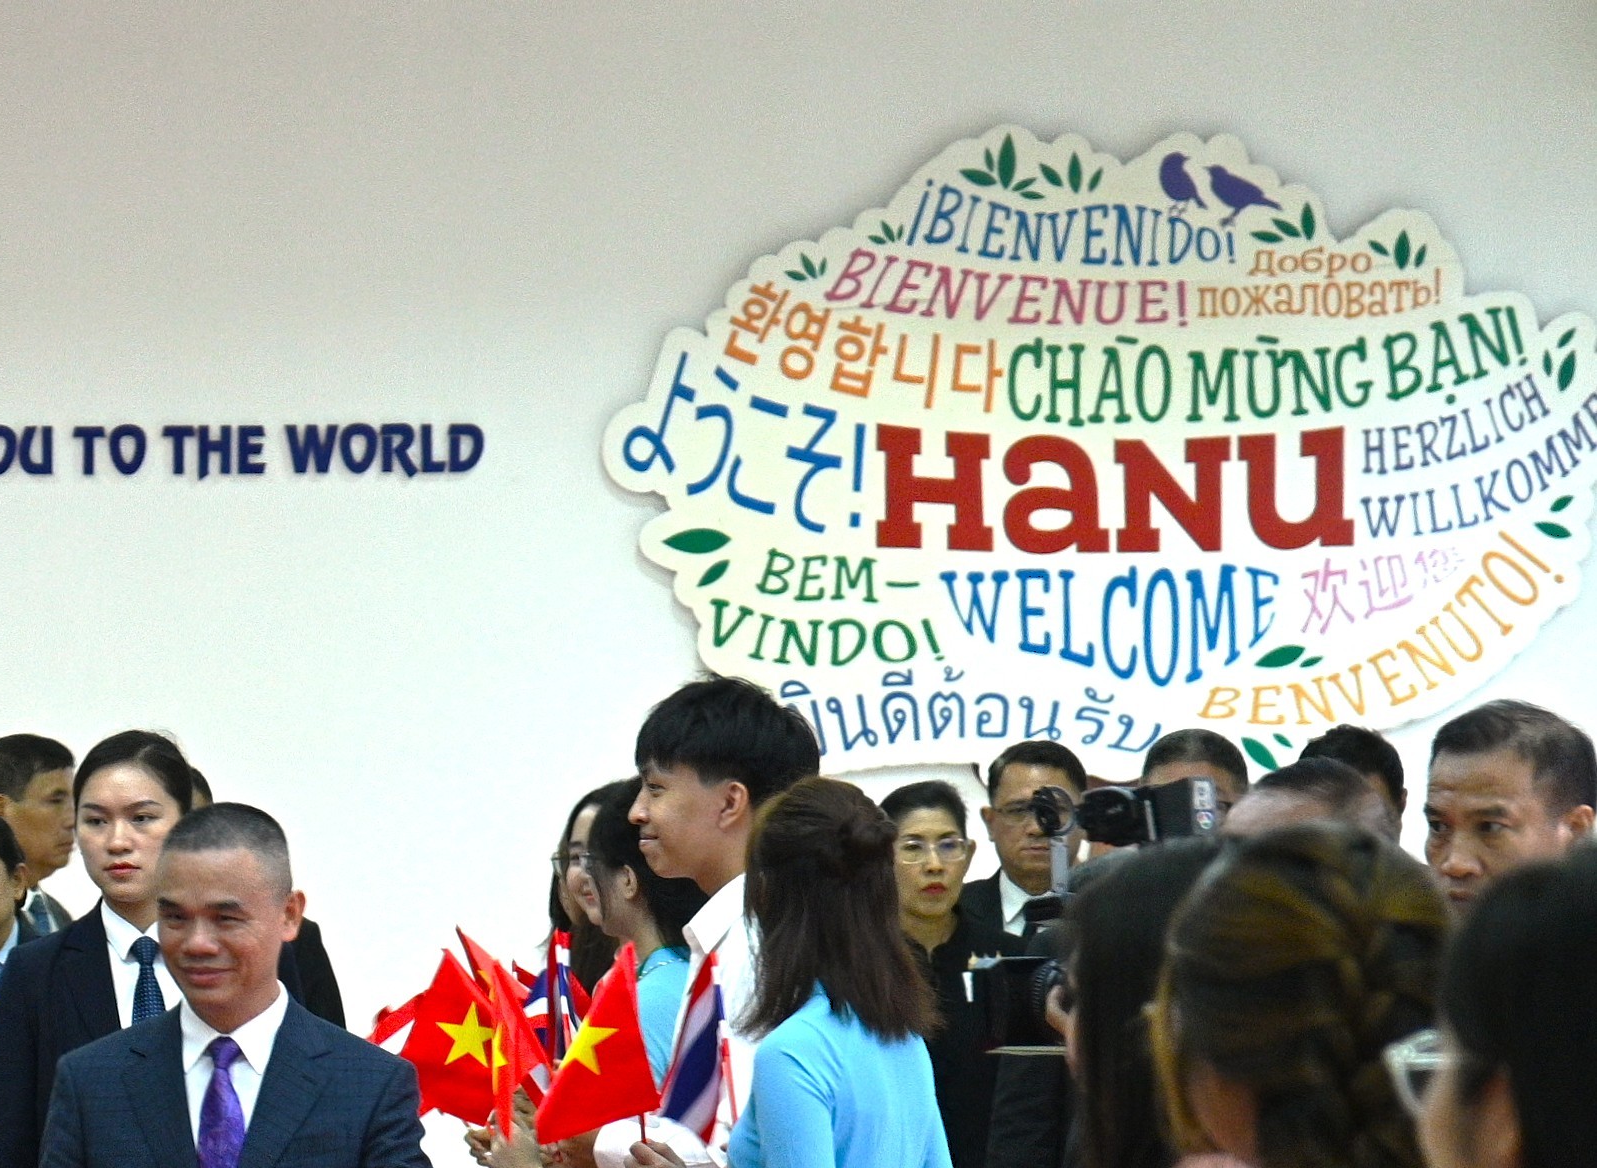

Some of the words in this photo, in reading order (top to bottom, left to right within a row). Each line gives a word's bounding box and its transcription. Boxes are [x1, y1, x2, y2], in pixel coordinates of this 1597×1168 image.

[824, 247, 1189, 327] BIENVENUE!
[1197, 267, 1442, 319] пожаловать!
[1247, 246, 1373, 279] Добро
[723, 280, 1003, 413] 환영합니다
[1382, 305, 1529, 405] BẠN!
[73, 424, 147, 476] TO
[162, 425, 265, 480] THE
[285, 423, 484, 478] WORLD
[622, 351, 866, 535] ようこそ!
[1360, 373, 1551, 475] HERZLICH
[709, 598, 947, 667] VINDO!
[939, 564, 1280, 687] WELCOME
[1197, 530, 1565, 725] BENVENUTO!
